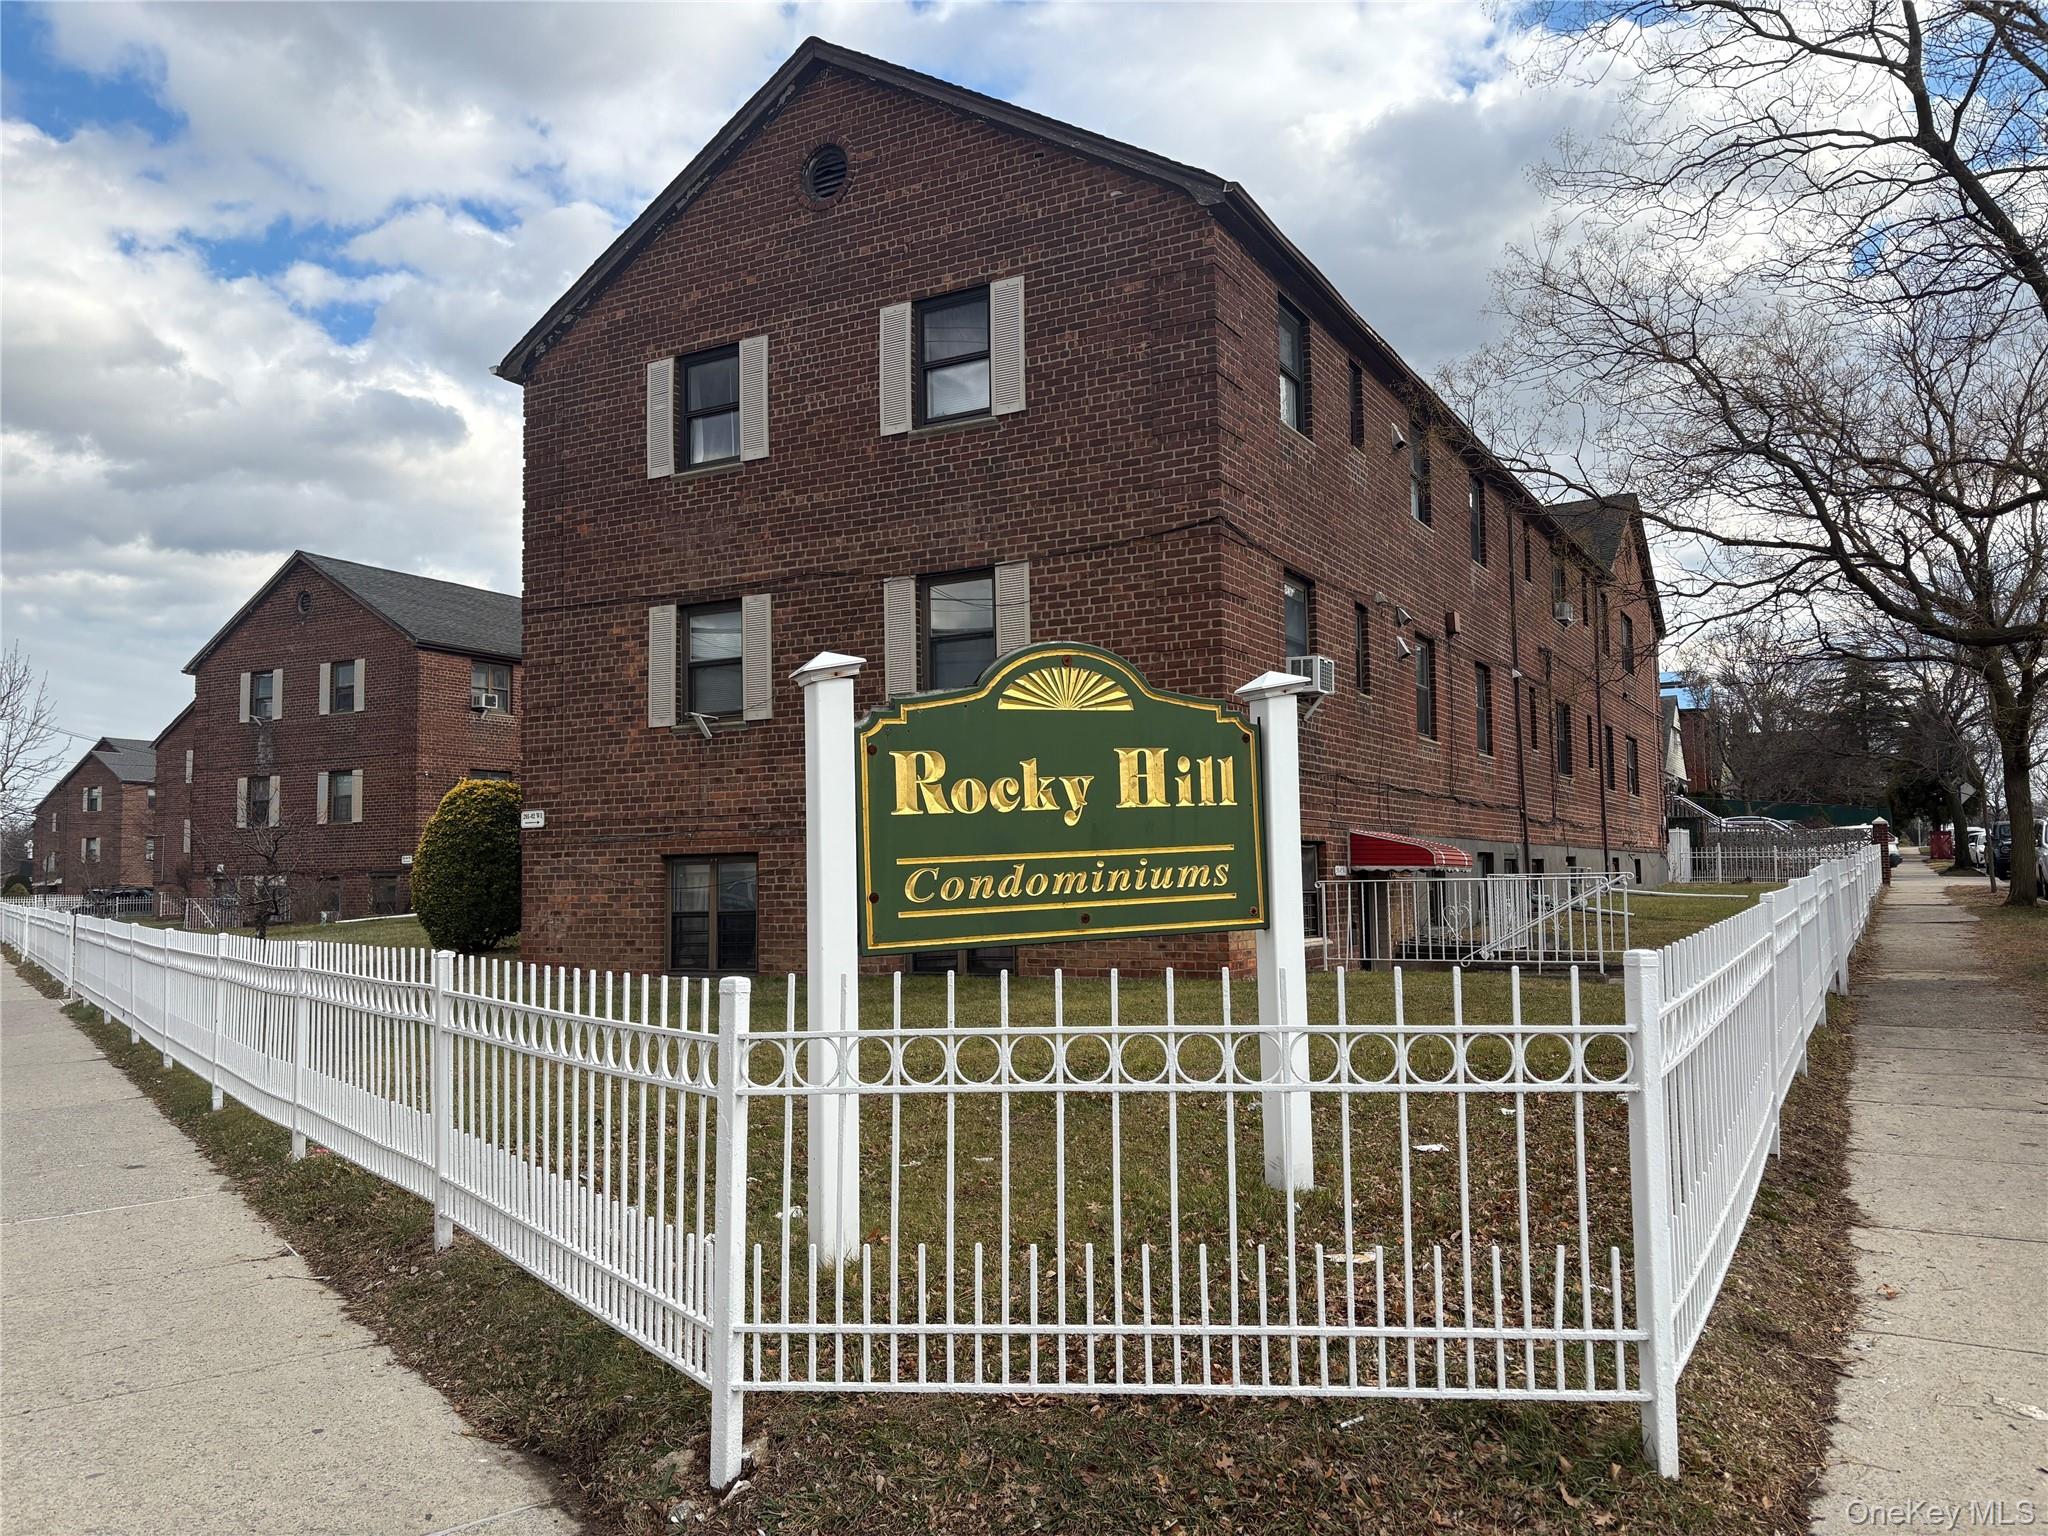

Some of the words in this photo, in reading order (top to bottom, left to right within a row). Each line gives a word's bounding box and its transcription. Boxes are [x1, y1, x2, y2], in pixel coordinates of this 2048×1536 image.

[888, 750, 1094, 827] Rocky
[1113, 747, 1238, 809] Hill
[904, 858, 1229, 903] Condominiums
